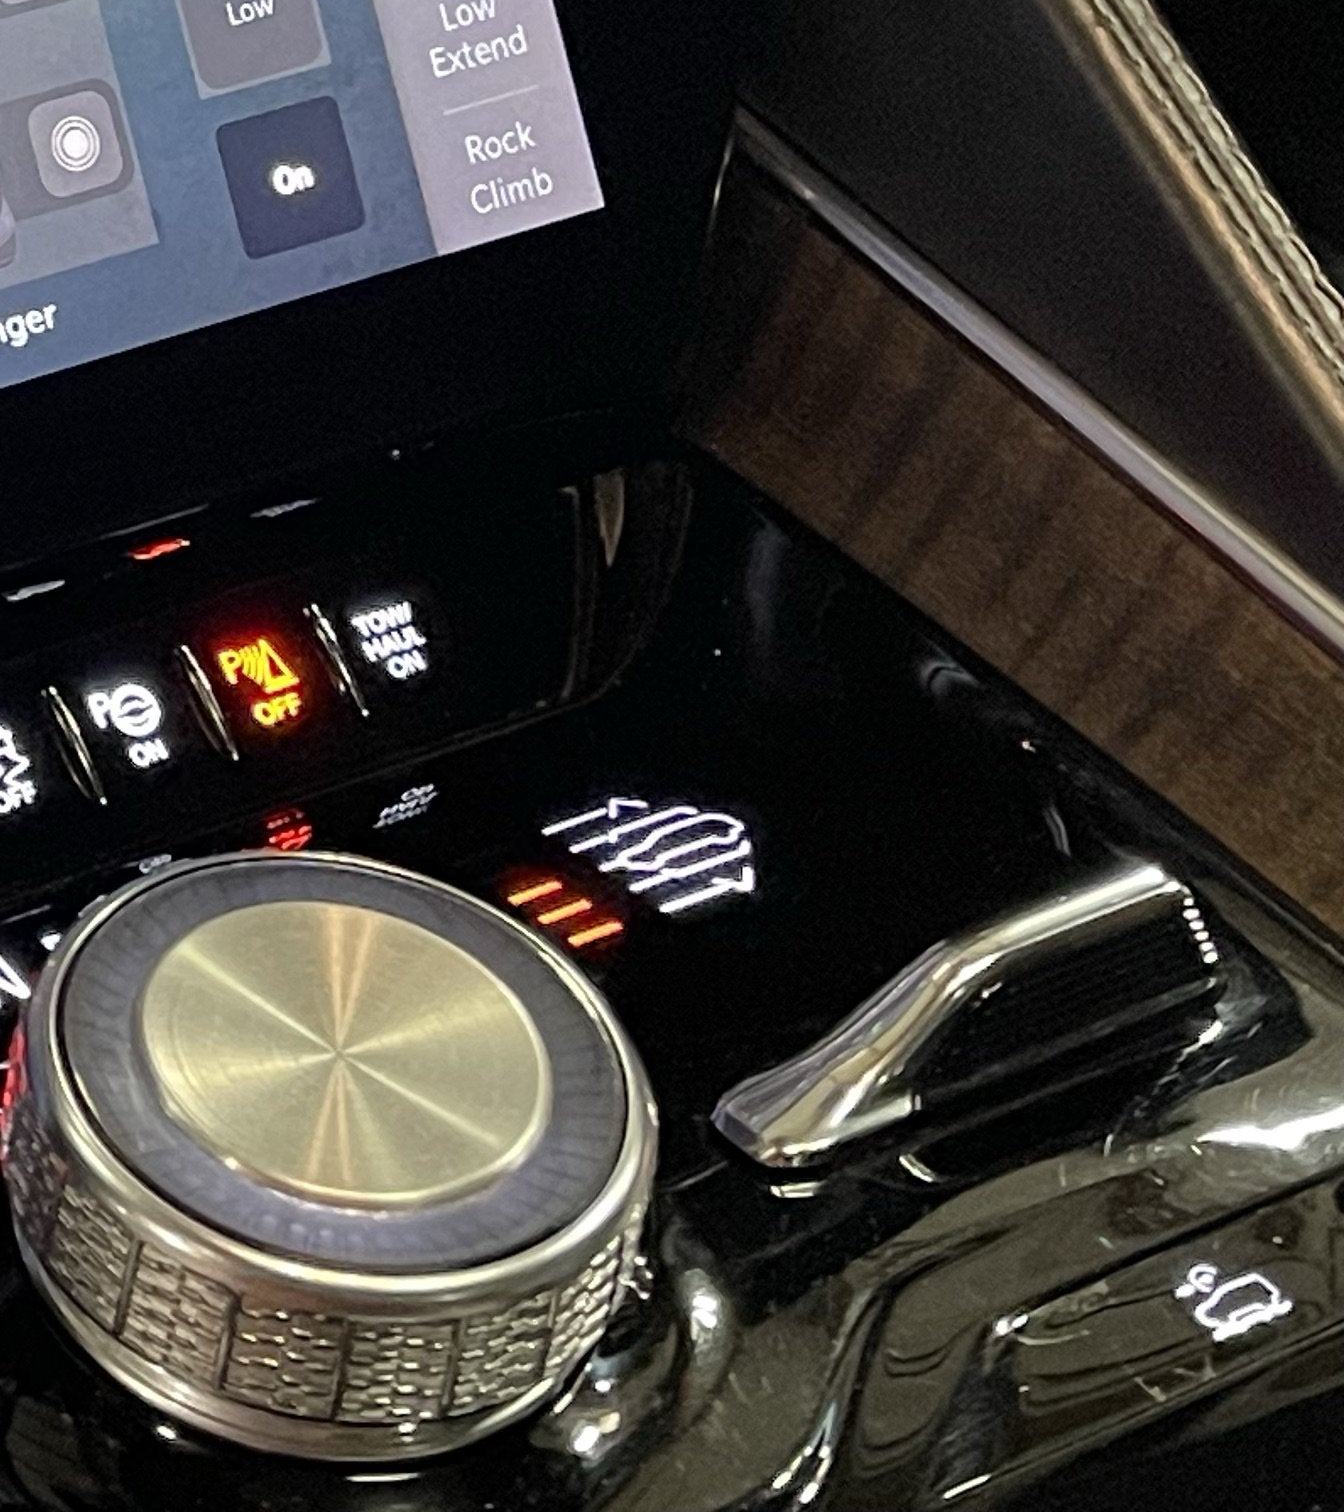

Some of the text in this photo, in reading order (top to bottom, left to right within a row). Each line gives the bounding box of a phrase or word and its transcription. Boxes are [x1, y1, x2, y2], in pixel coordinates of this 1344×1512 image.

[428, 25, 529, 79] Extend
[464, 121, 536, 165] Rock
[271, 162, 315, 195] On
[470, 168, 553, 215] Climb
[362, 627, 427, 663] HAUL
[387, 651, 427, 680] ON
[252, 692, 302, 726] OFF
[129, 739, 169, 767] ON
